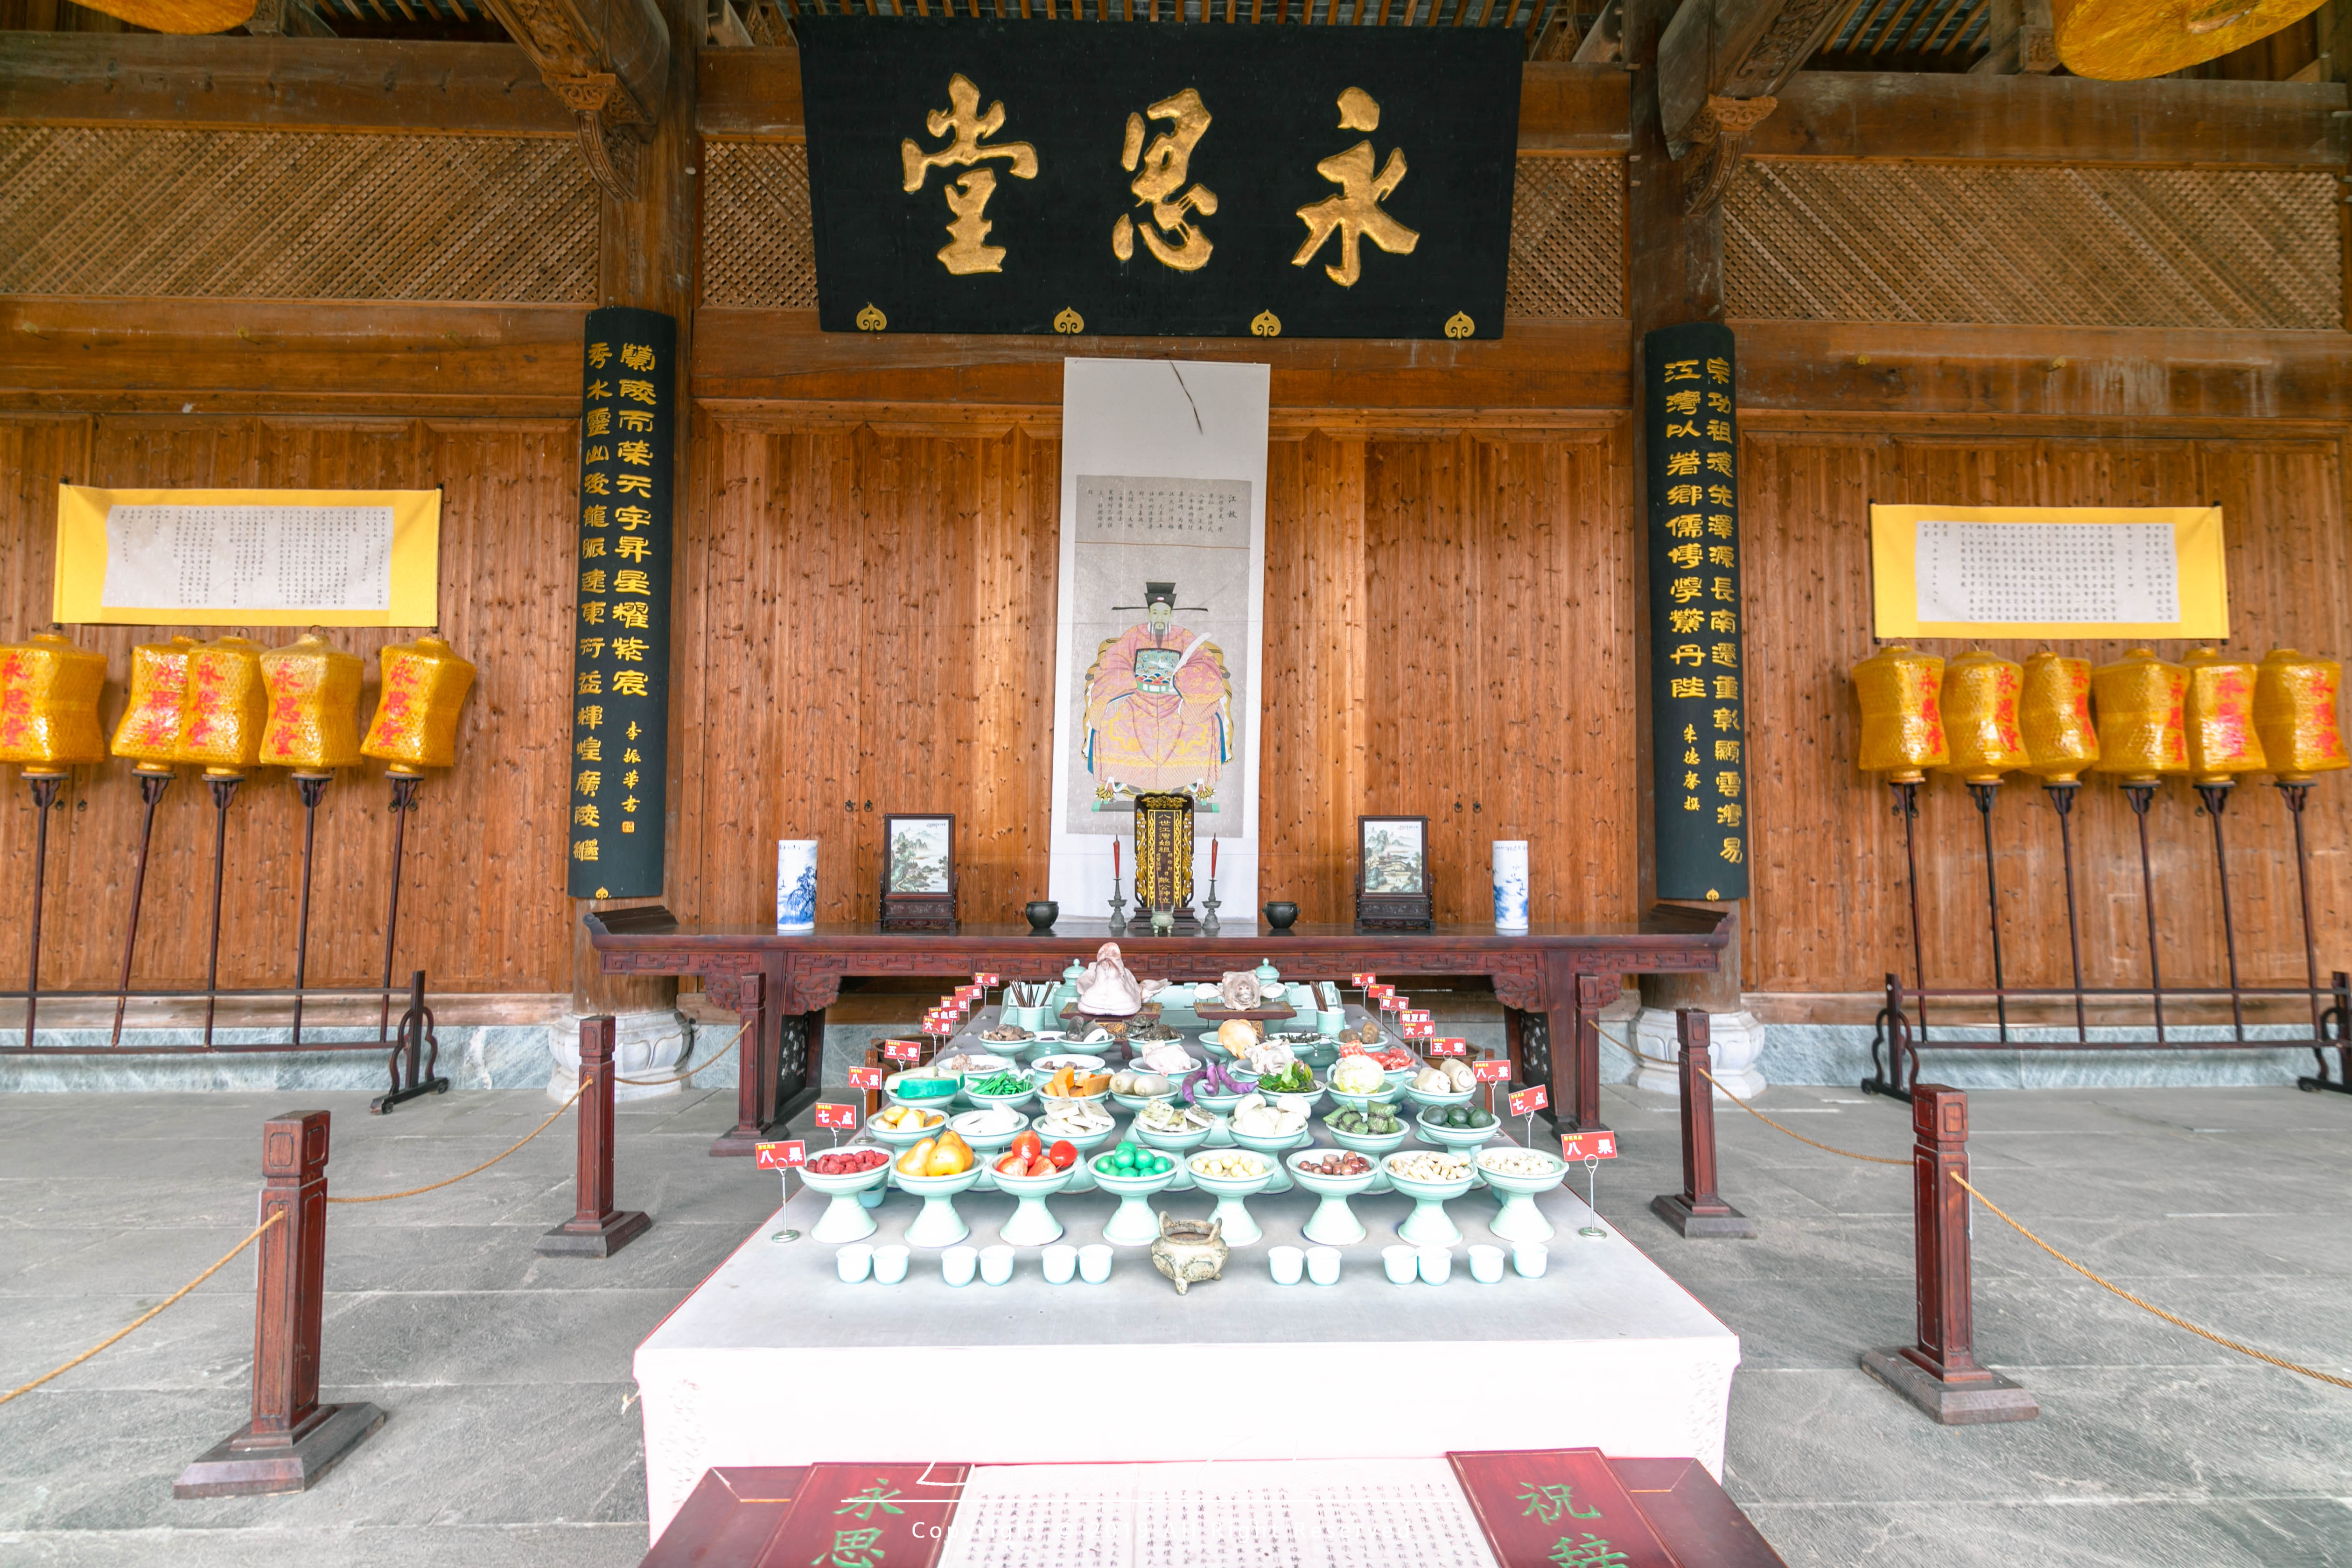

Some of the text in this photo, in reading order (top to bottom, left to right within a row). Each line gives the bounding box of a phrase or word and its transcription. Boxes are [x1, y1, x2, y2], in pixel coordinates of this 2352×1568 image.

[903, 73, 1420, 287] 永思堂
[0, 654, 31, 747] 永思堂
[271, 662, 302, 756] 永思堂
[376, 658, 418, 747] 永思堂
[1995, 667, 2020, 752] 永思堂
[818, 1110, 853, 1125] 七点
[1512, 1092, 1546, 1111] 七点
[760, 1147, 803, 1164] 八果
[1567, 1139, 1613, 1156] 八果
[810, 1477, 905, 1568] 永思
